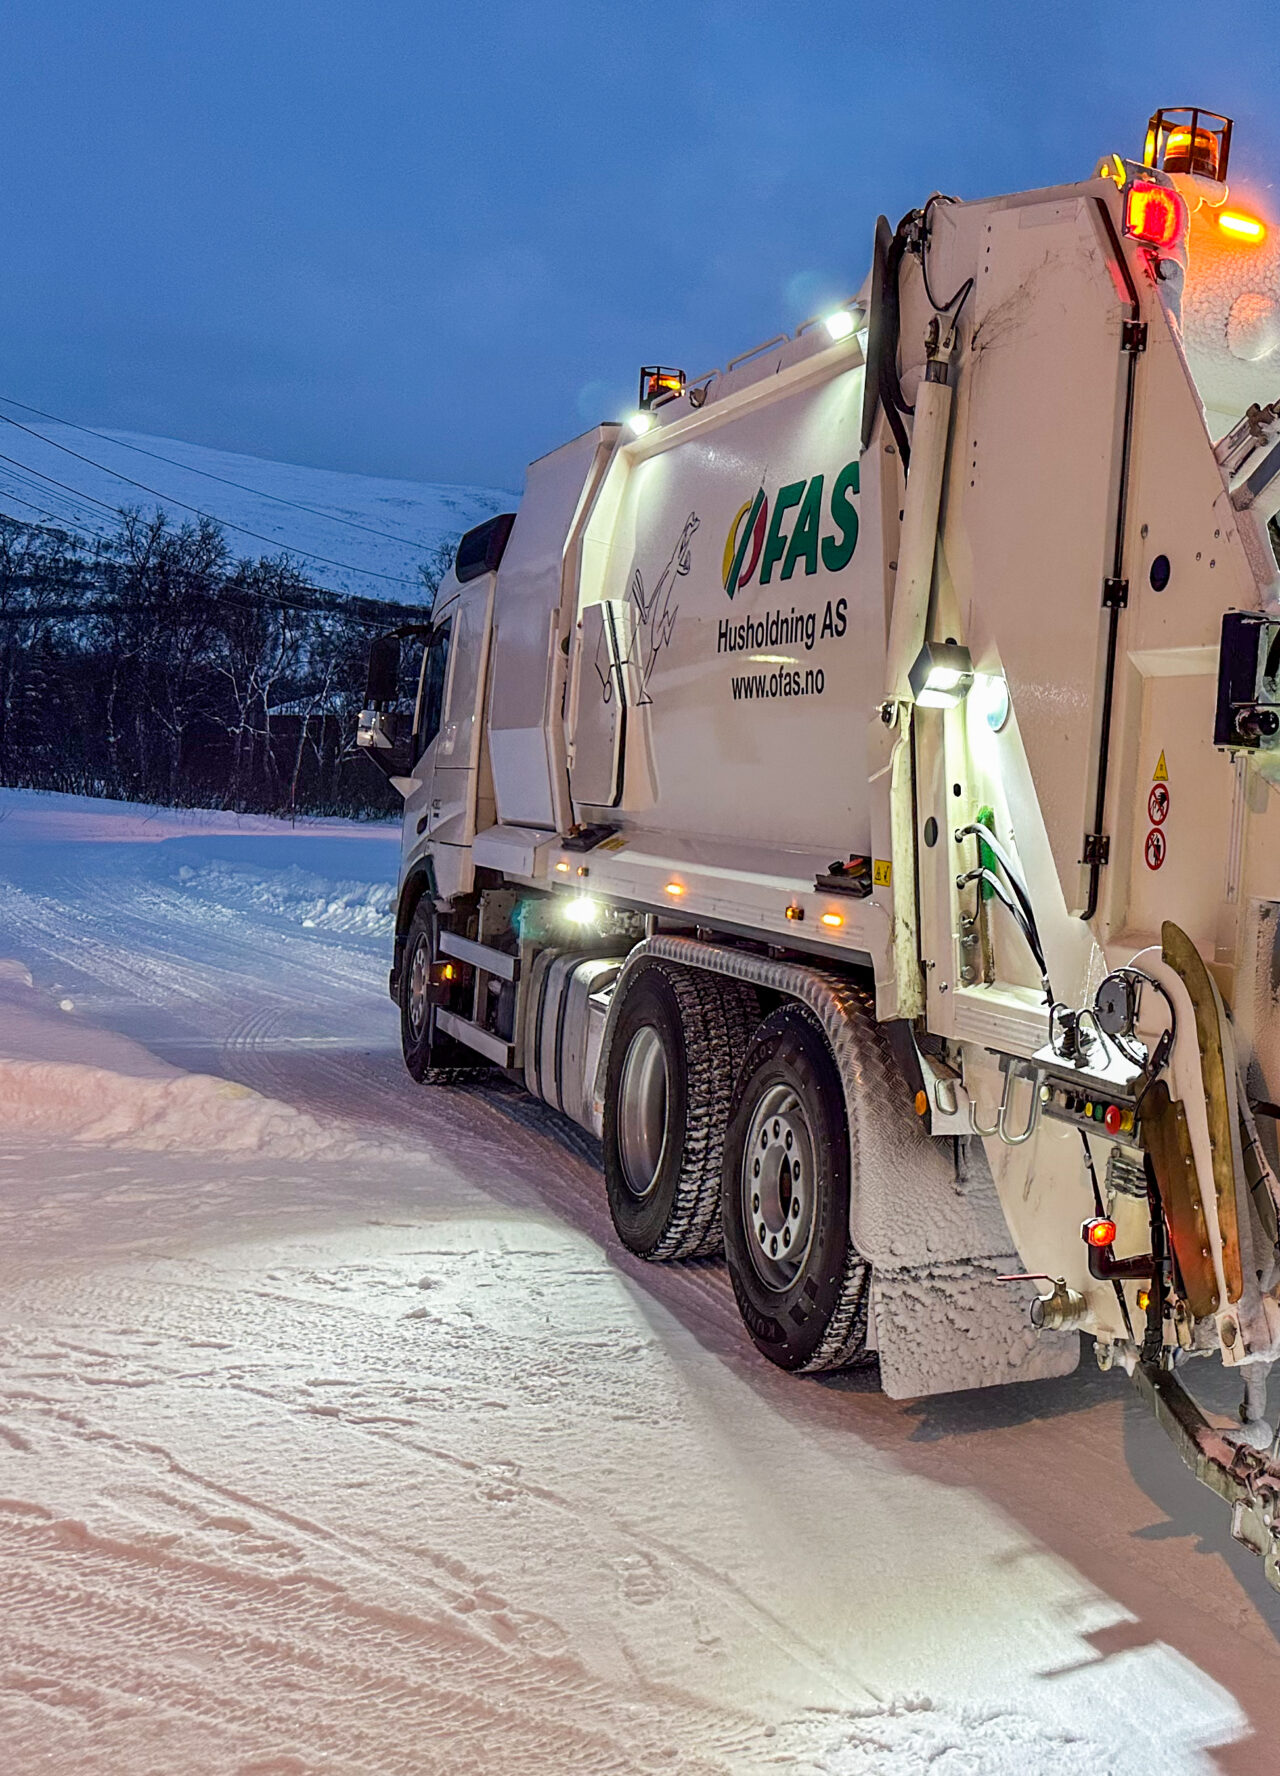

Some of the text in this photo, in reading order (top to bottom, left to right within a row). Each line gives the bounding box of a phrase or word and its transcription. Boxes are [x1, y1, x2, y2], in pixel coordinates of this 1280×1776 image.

[717, 598, 848, 652] Husholdning AS
[732, 665, 825, 700] www.ofas.no
